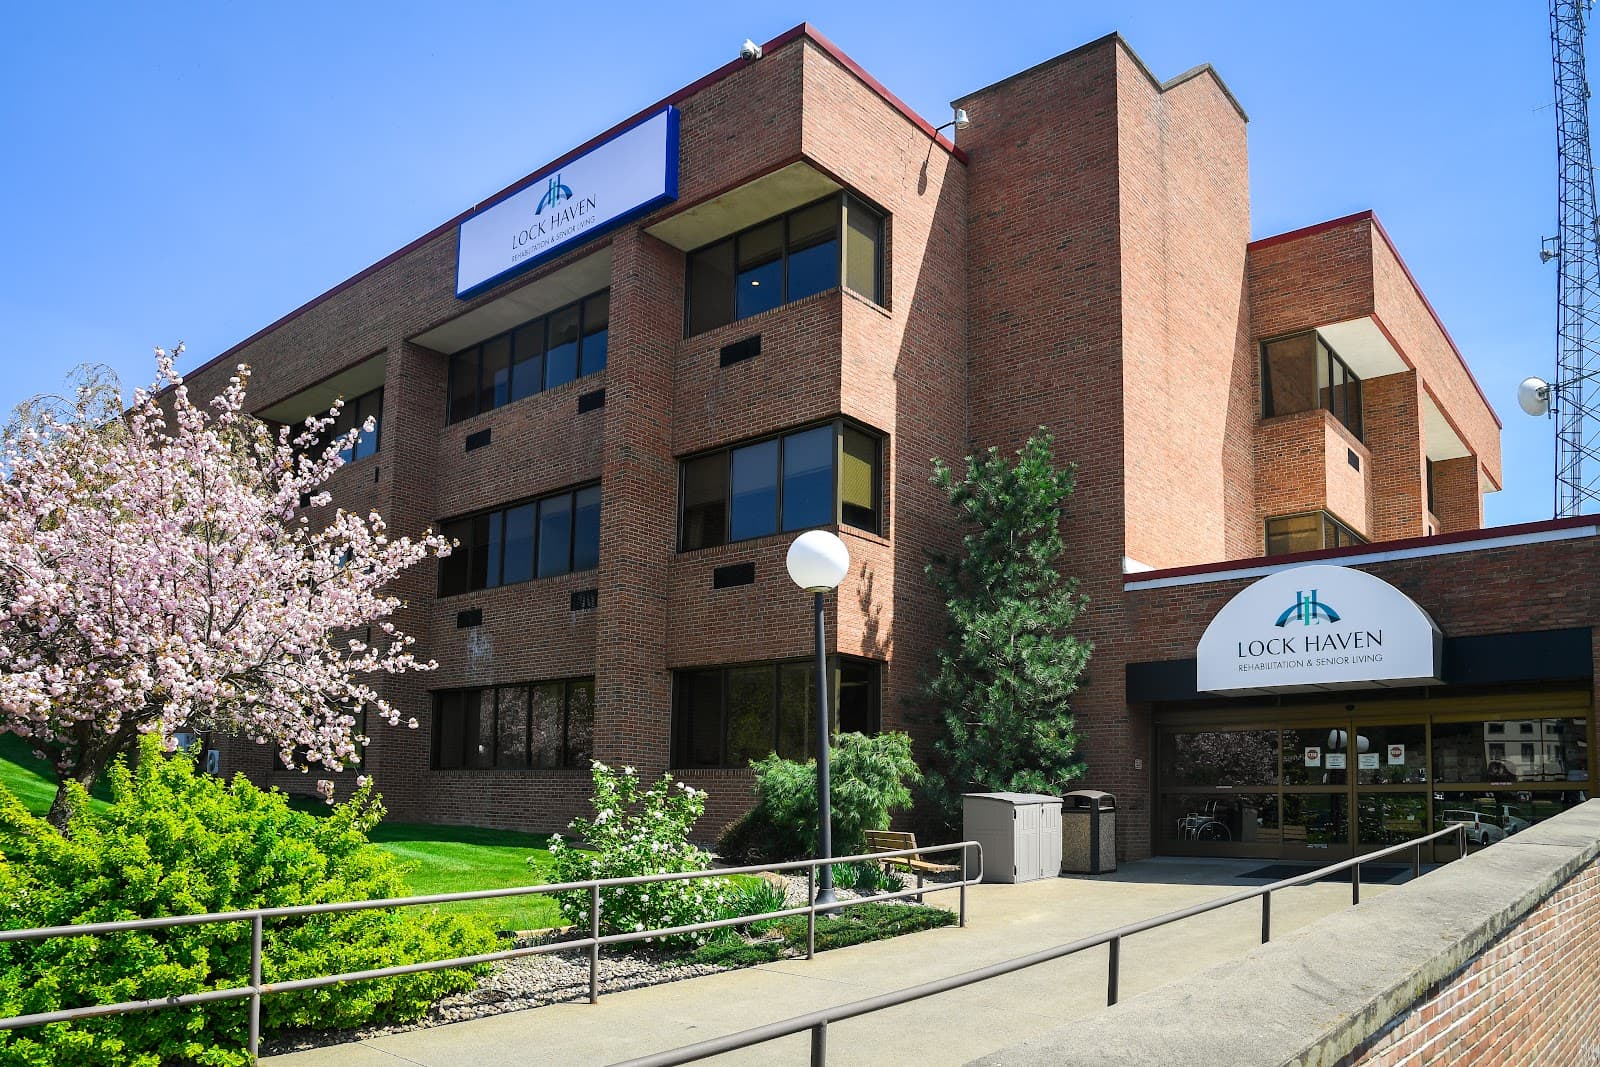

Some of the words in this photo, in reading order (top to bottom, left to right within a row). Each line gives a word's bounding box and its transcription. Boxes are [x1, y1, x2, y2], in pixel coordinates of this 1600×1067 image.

[512, 219, 546, 249] LOCK
[551, 193, 596, 230] HAVEN
[1238, 636, 1296, 658] LOCK
[1305, 629, 1382, 652] HAVEN
[1238, 660, 1304, 672] REHABILITATION
[1306, 659, 1313, 667] &
[1315, 656, 1350, 667] SENIOR
[1352, 653, 1383, 663] LIVING
